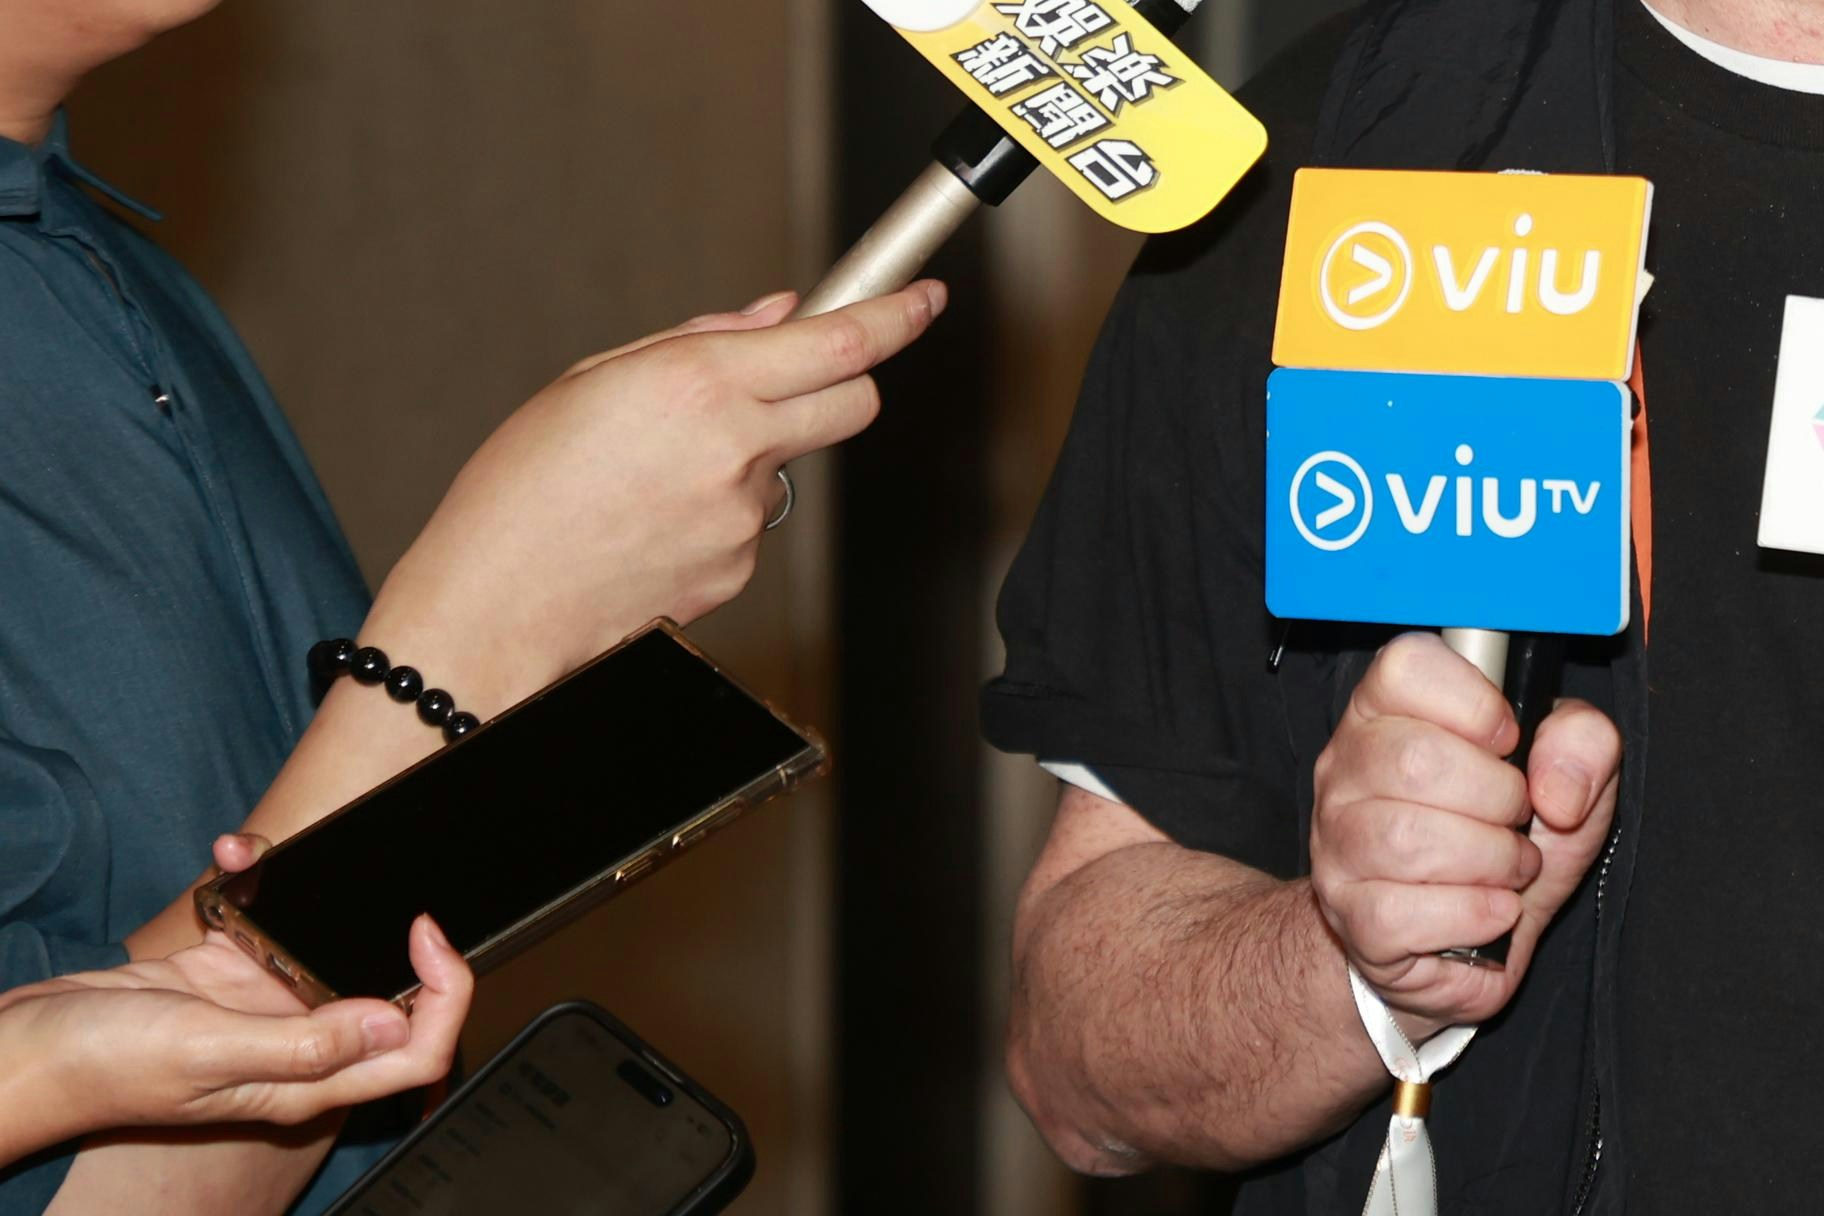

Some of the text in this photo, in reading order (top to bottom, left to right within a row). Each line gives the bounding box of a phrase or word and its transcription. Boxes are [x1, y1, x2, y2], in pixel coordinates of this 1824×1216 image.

[951, 31, 1158, 202] 新聞台
[1432, 212, 1600, 315] viu
